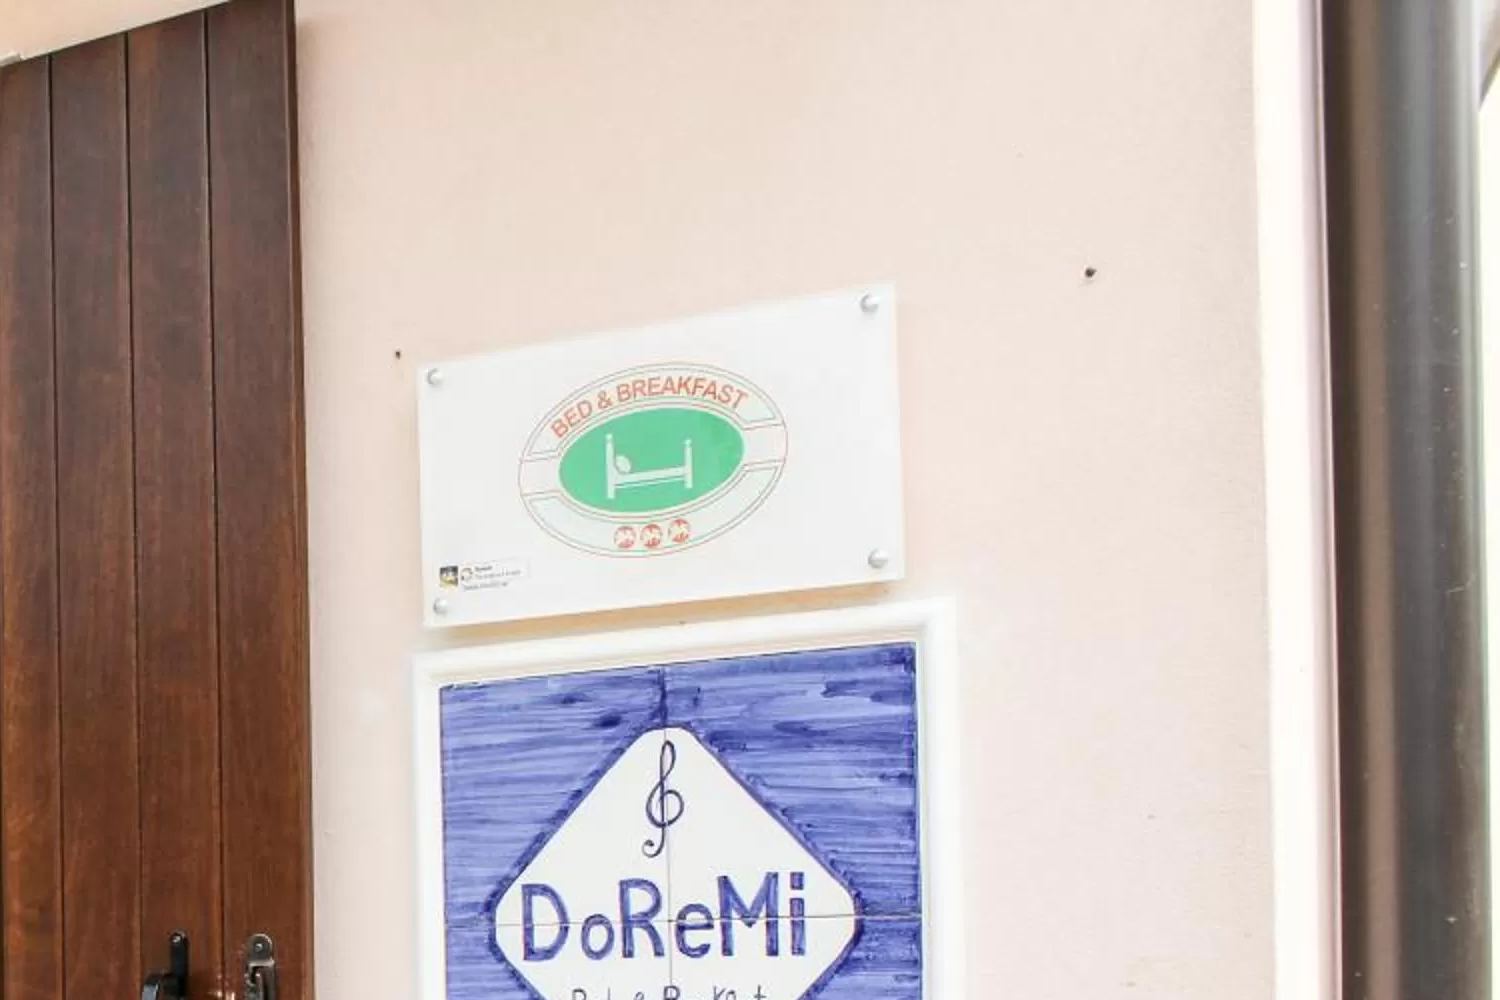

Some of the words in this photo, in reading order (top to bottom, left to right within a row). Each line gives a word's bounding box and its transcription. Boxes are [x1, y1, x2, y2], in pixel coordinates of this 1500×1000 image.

[551, 400, 592, 438] BED
[597, 390, 612, 409] &
[615, 375, 748, 410] BREAKFAST
[521, 871, 805, 960] DoReMi
